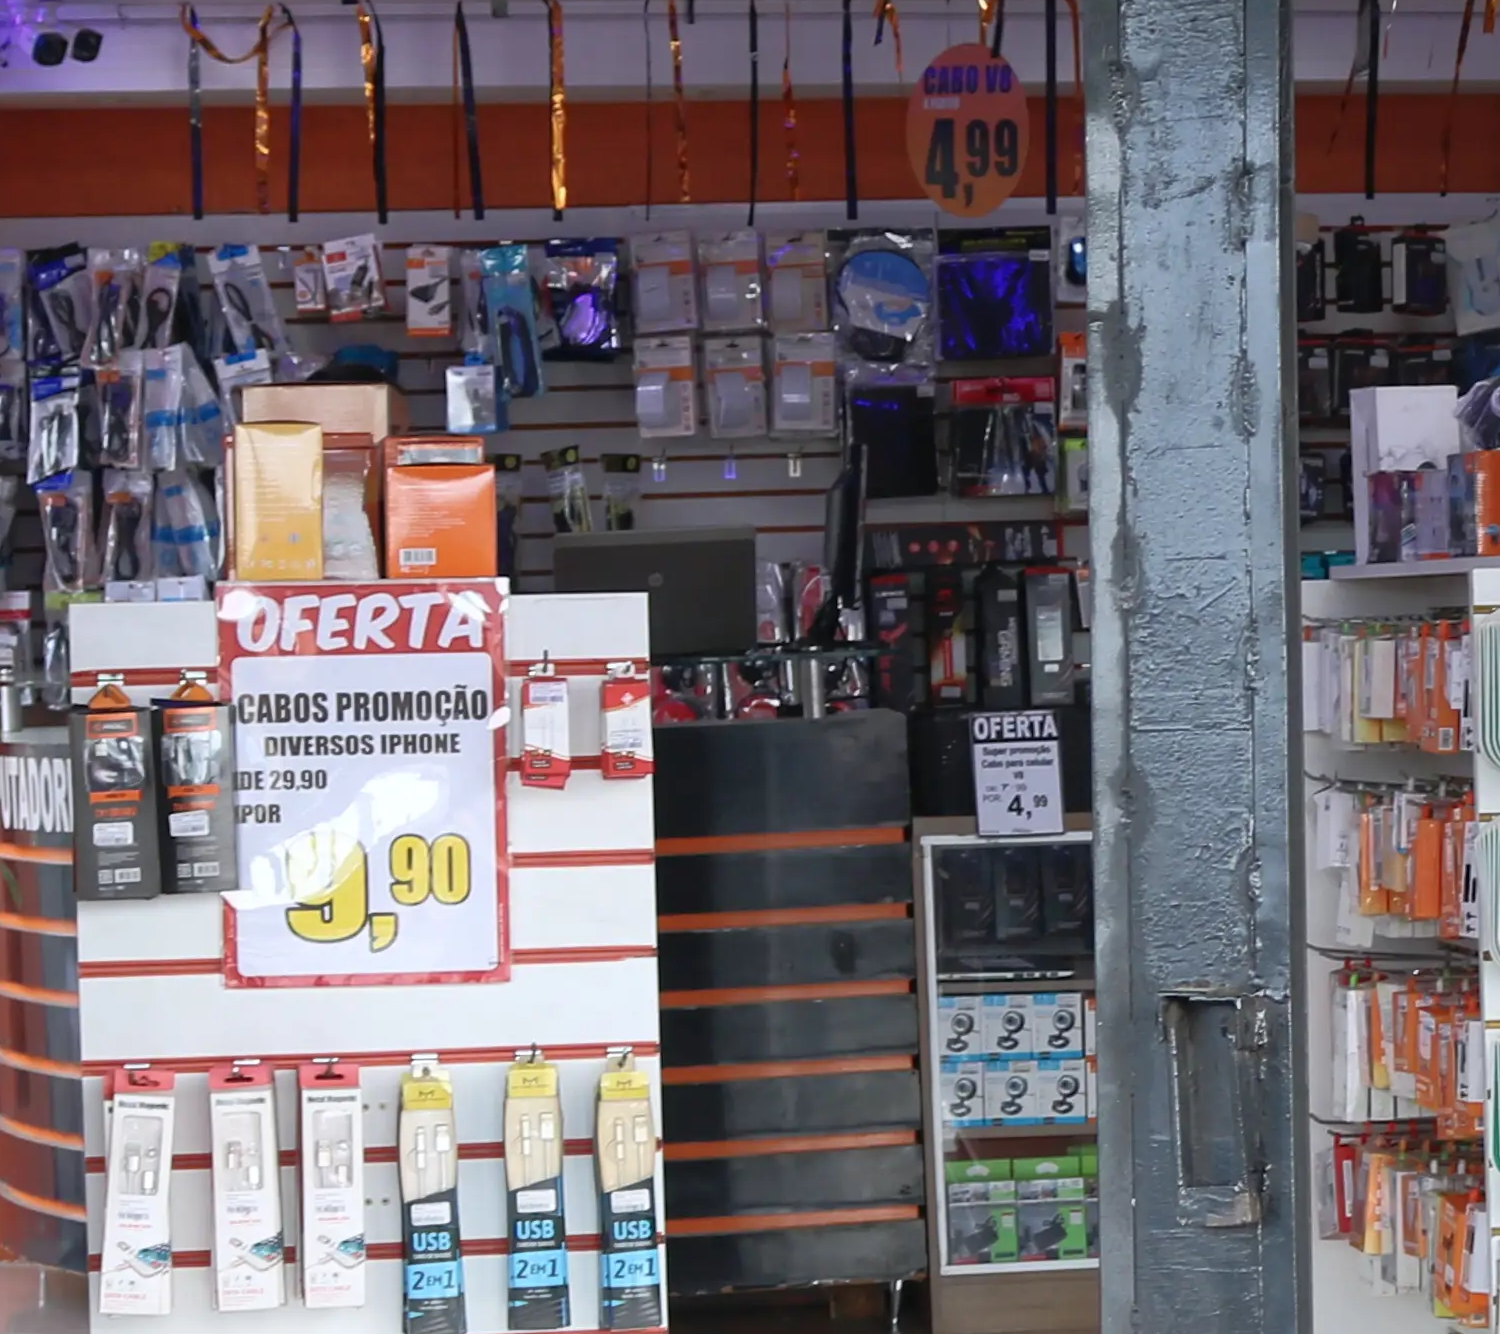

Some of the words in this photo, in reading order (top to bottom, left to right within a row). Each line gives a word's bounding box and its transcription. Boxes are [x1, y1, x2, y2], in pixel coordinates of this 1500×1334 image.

[924, 64, 979, 95] CABO
[925, 118, 1018, 208] 4,99
[235, 591, 484, 653] OFERTA
[237, 691, 329, 725] CABOS
[336, 684, 489, 727] PROMOÇÃO
[973, 715, 1059, 740] OFERTA
[264, 734, 375, 757] DIVERSOS
[380, 732, 461, 755] IPHONE
[238, 770, 263, 791] DE
[269, 769, 328, 791] 29,90
[239, 803, 282, 825] POR
[1006, 794, 1049, 821] 4,99
[285, 829, 472, 954] 9,90
[515, 1219, 555, 1240] USB
[613, 1220, 652, 1241] USB
[412, 1231, 452, 1252] USB
[411, 1270, 425, 1291] 2
[426, 1273, 443, 1287] EM
[443, 1269, 456, 1288] 1
[515, 1259, 529, 1280] 2
[530, 1261, 547, 1275] EM
[547, 1258, 560, 1278] 1
[613, 1259, 627, 1280] 2
[627, 1261, 644, 1275] EM
[645, 1258, 657, 1277] 1
